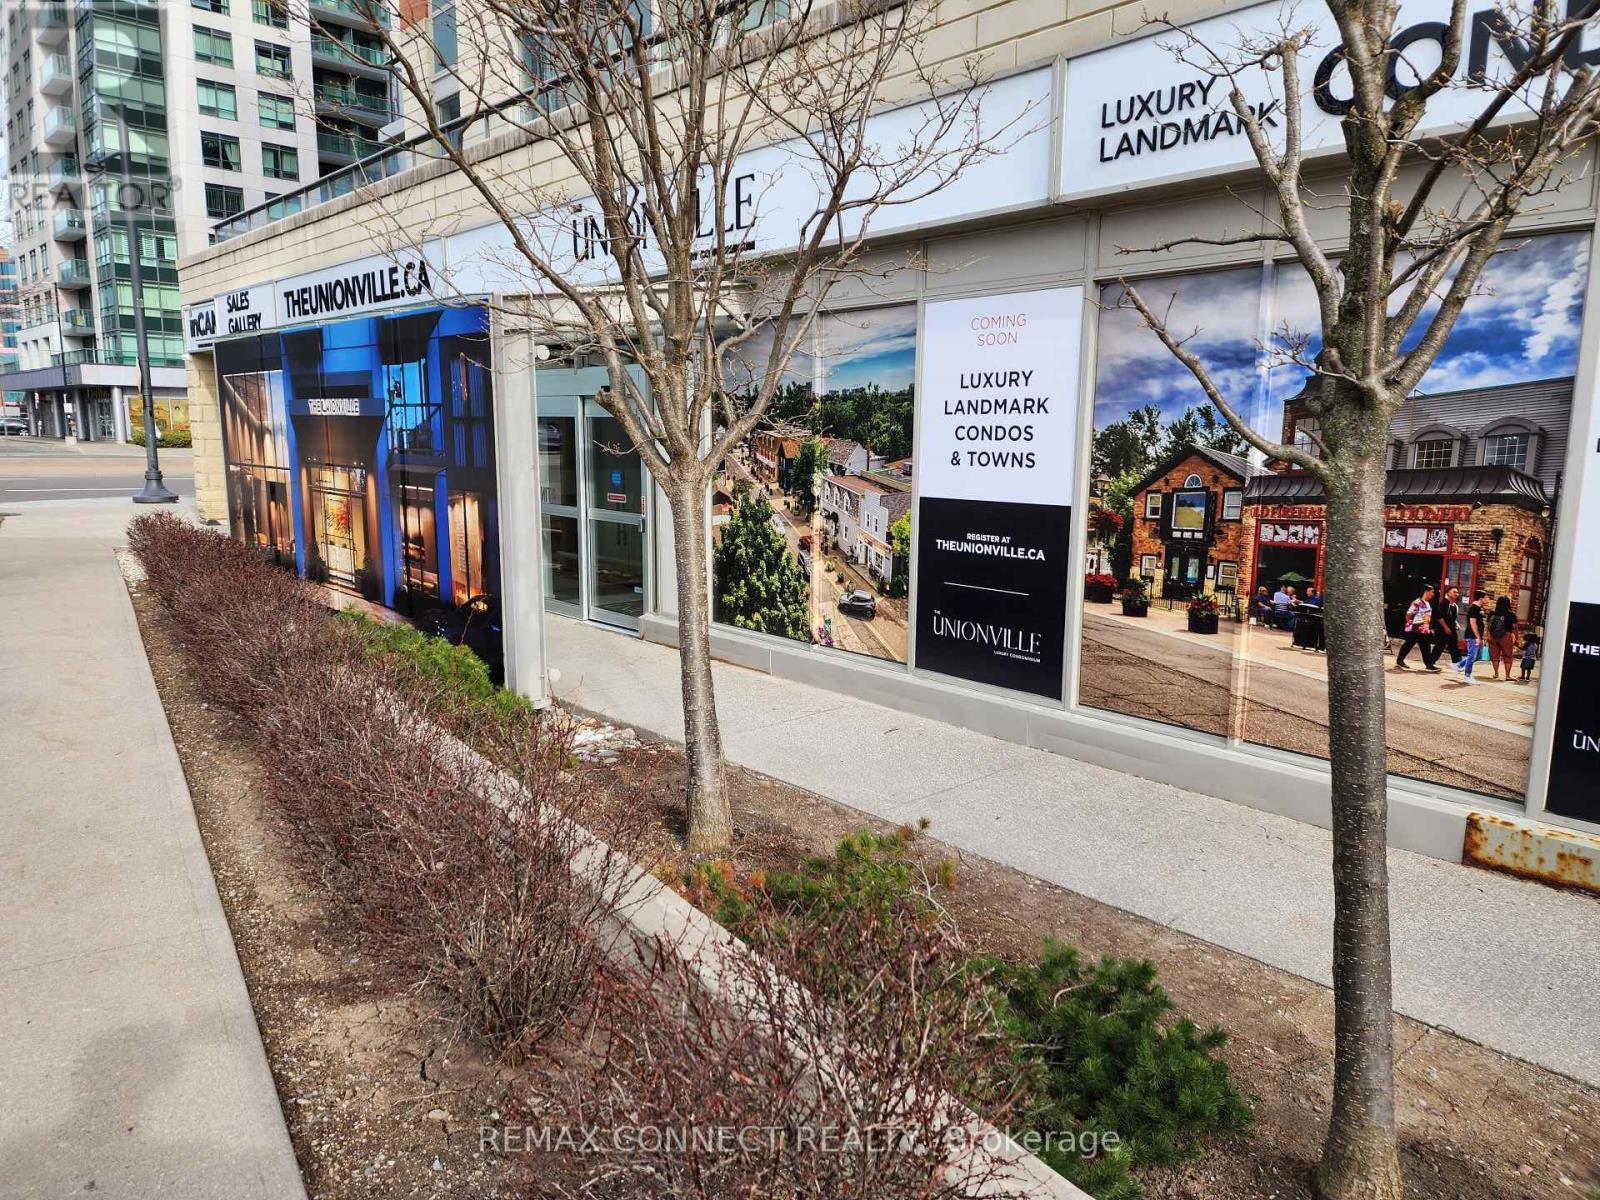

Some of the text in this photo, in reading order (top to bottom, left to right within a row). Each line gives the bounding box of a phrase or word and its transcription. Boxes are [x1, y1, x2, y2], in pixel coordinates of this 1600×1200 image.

[1100, 75, 1217, 129] LUXURY
[1099, 98, 1280, 163] LANDMARK
[283, 259, 432, 319] THEUNIONVILLE.CA
[226, 290, 250, 314] SALES
[228, 312, 262, 334] GALLERY
[970, 313, 1027, 331] COMING
[977, 331, 1018, 347] SOON
[960, 370, 1034, 389] LUXURY
[944, 397, 1050, 415] LANDMARK
[954, 425, 1034, 442] CONDOS
[950, 451, 1036, 468] & TOWNS
[966, 533, 1000, 543] REGISTER
[935, 539, 1046, 561] THEUNIONVILLE.CA
[933, 615, 1041, 655] UNIONVILLE
